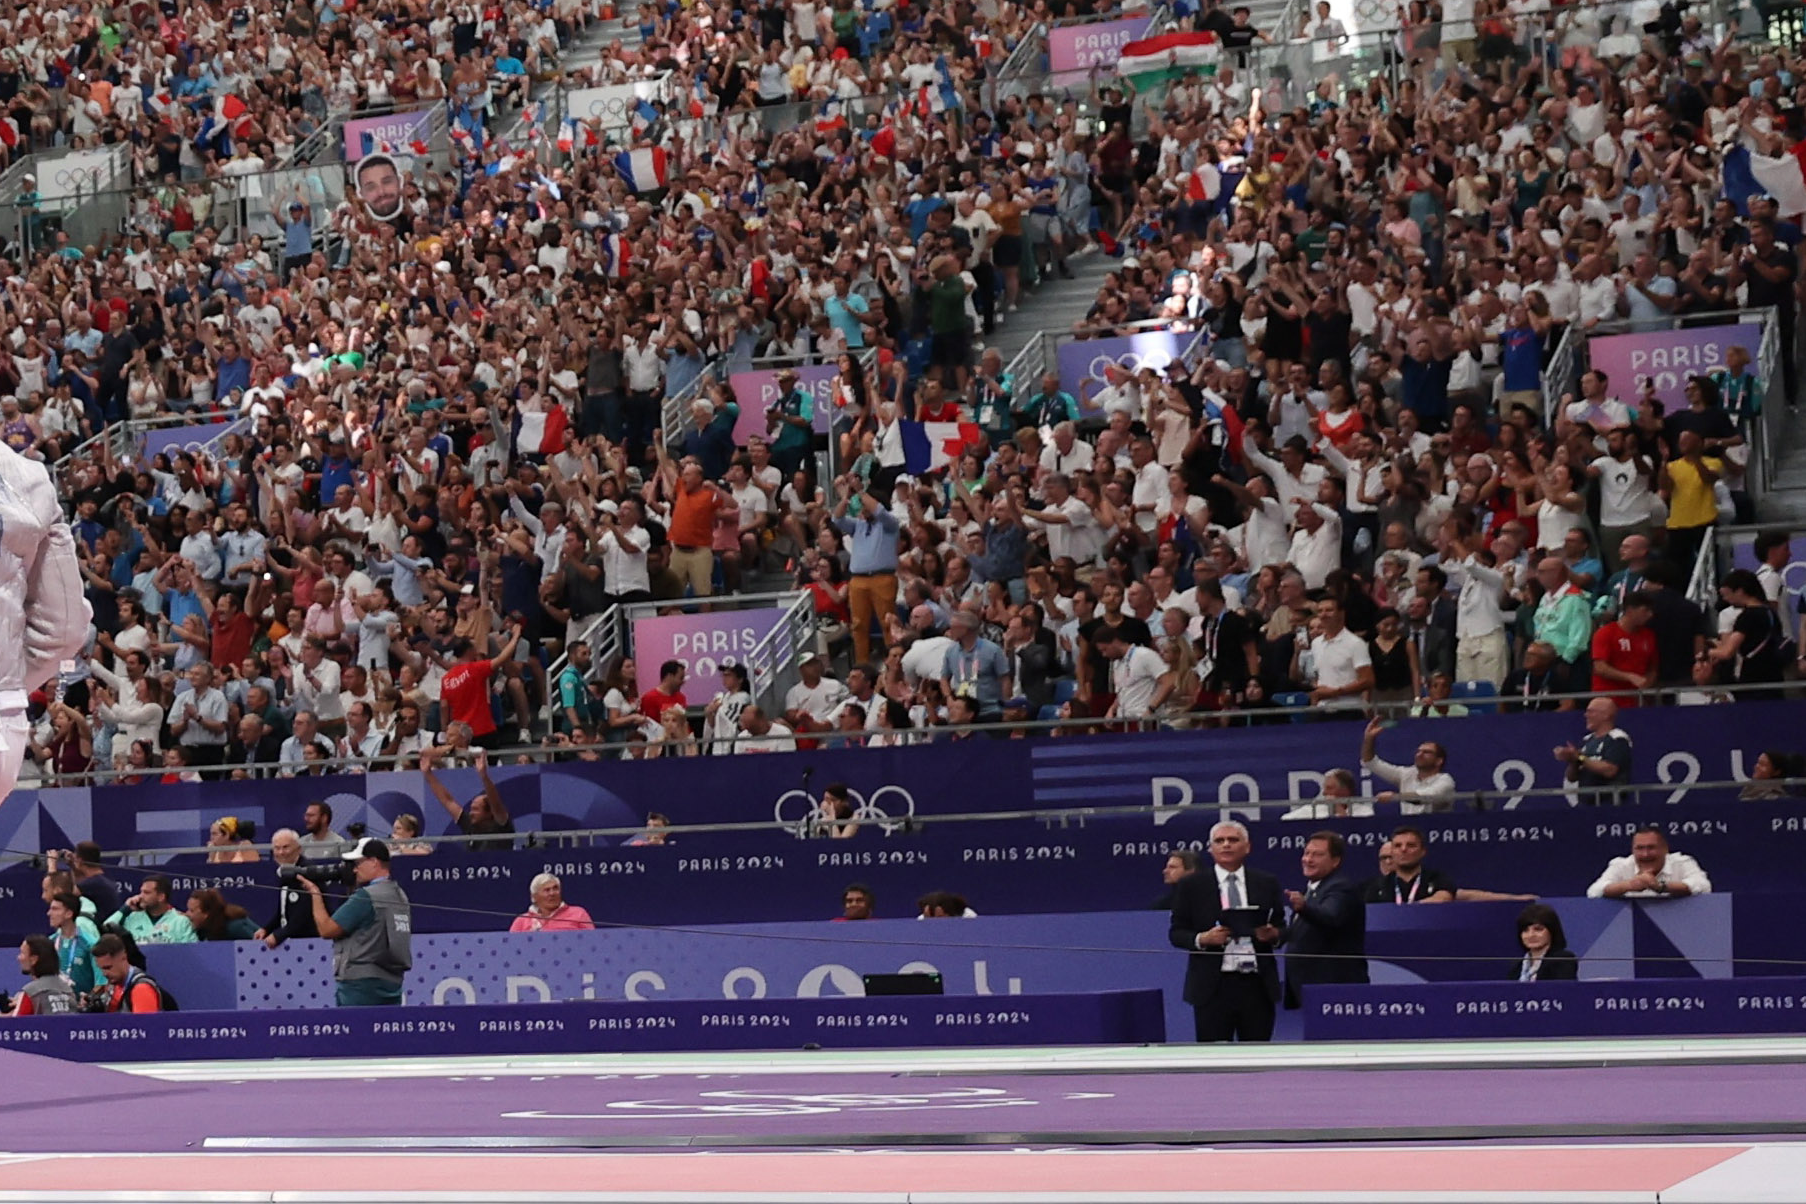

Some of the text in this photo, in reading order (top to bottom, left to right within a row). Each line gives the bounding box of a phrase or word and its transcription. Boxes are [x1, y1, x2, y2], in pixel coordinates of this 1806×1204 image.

[1077, 47, 1118, 67] 202
[1631, 343, 1720, 369] PARIS
[1497, 825, 1554, 841] 2024
[1668, 819, 1728, 836] 2024
[1347, 832, 1393, 846] 024
[878, 851, 928, 865] 2024
[1025, 846, 1076, 861] 2024
[599, 860, 645, 875] 2024
[736, 856, 785, 870] 2024
[466, 865, 512, 880] 2024
[1378, 1002, 1425, 1015] 2024
[1514, 999, 1562, 1013] 2024
[1654, 997, 1706, 1010] 2024
[636, 1016, 677, 1028] 2024
[750, 1014, 790, 1026] 2024
[866, 1014, 909, 1026] 2024
[986, 1011, 1030, 1024] 2024
[312, 1024, 350, 1036] 2024
[418, 1020, 456, 1032] 2024
[526, 1019, 564, 1031] 2024
[14, 1030, 48, 1041] 2024
[112, 1029, 147, 1040] 2024
[211, 1026, 247, 1039] 2024
